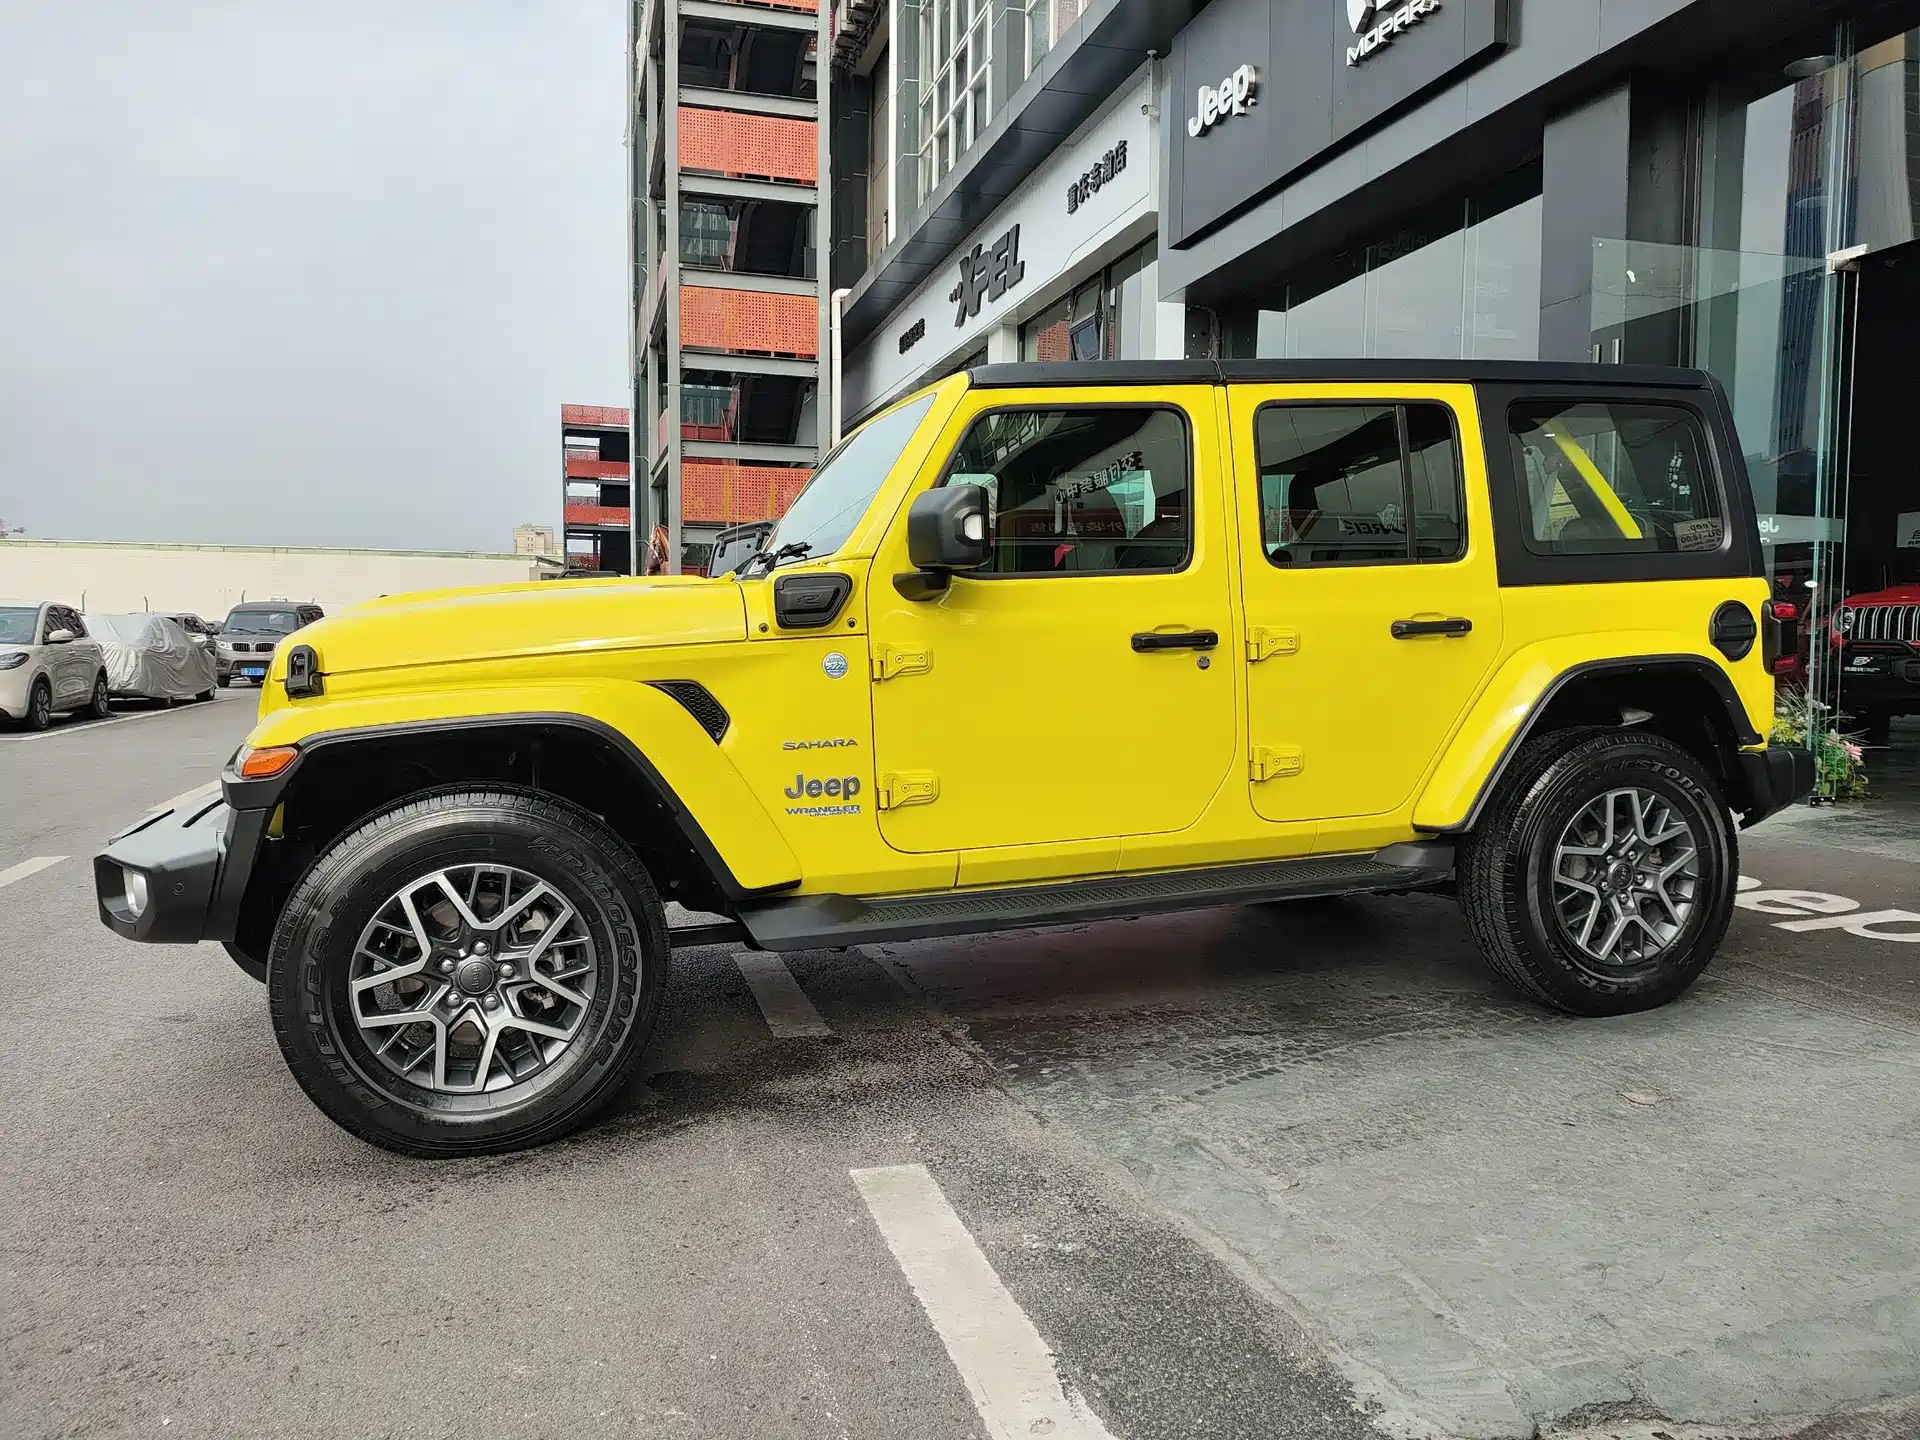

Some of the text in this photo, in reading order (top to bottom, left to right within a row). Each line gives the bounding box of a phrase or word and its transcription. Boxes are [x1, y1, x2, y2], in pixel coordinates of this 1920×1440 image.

[1346, 0, 1425, 67] MOPAR
[1188, 64, 1256, 138] Jeep
[953, 224, 1025, 328] XPEL
[782, 738, 858, 750] SAHARA
[784, 773, 860, 800] Jeep
[784, 804, 861, 815] WRANGLER
